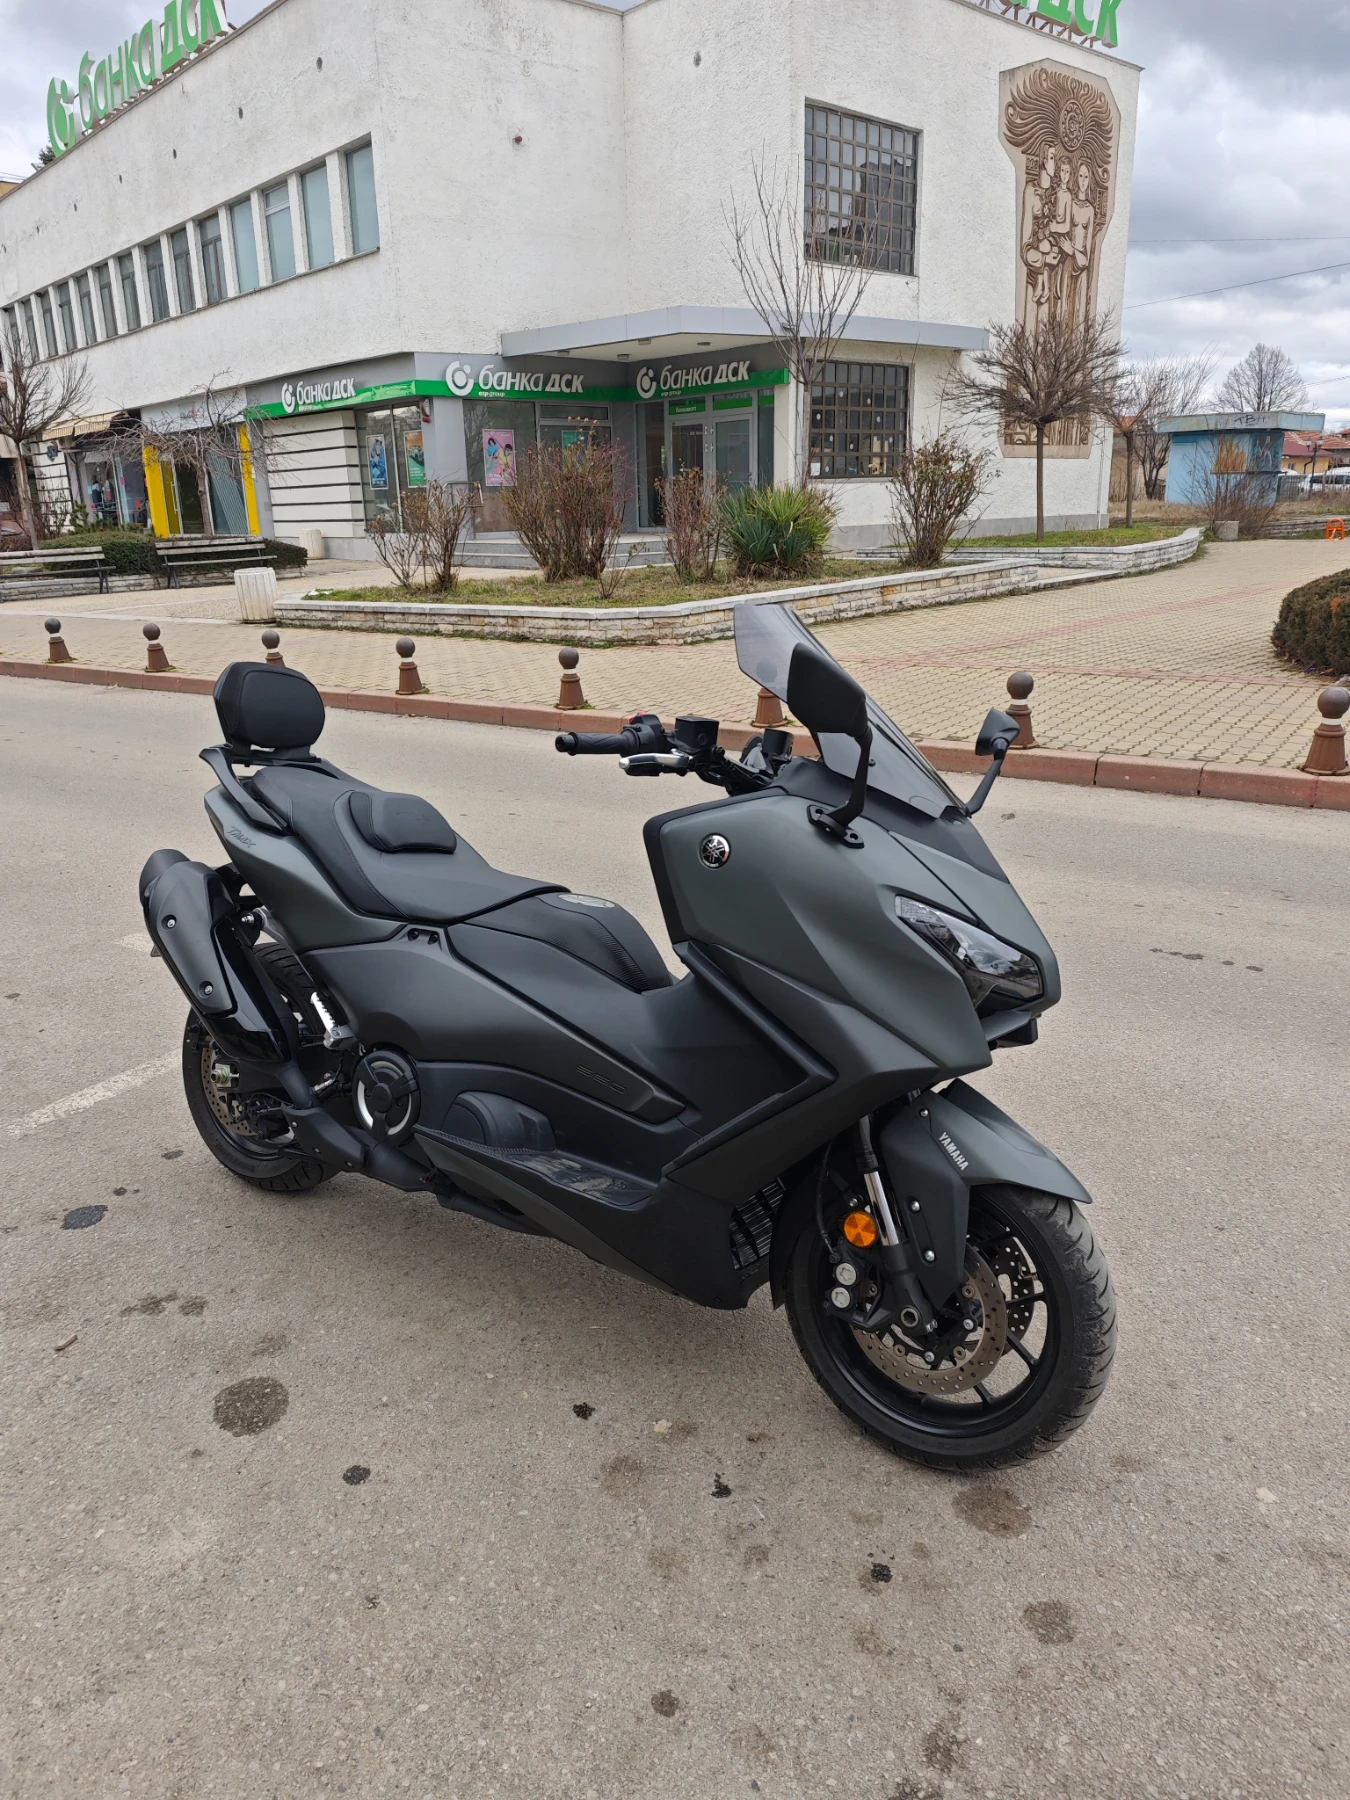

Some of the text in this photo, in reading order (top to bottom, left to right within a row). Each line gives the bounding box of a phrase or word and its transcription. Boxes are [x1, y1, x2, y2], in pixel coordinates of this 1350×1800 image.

[78, 19, 160, 130] банка
[479, 364, 543, 391] банка
[660, 365, 713, 390] банка
[296, 381, 331, 405] банка
[939, 1131, 969, 1170] YAMAHA
